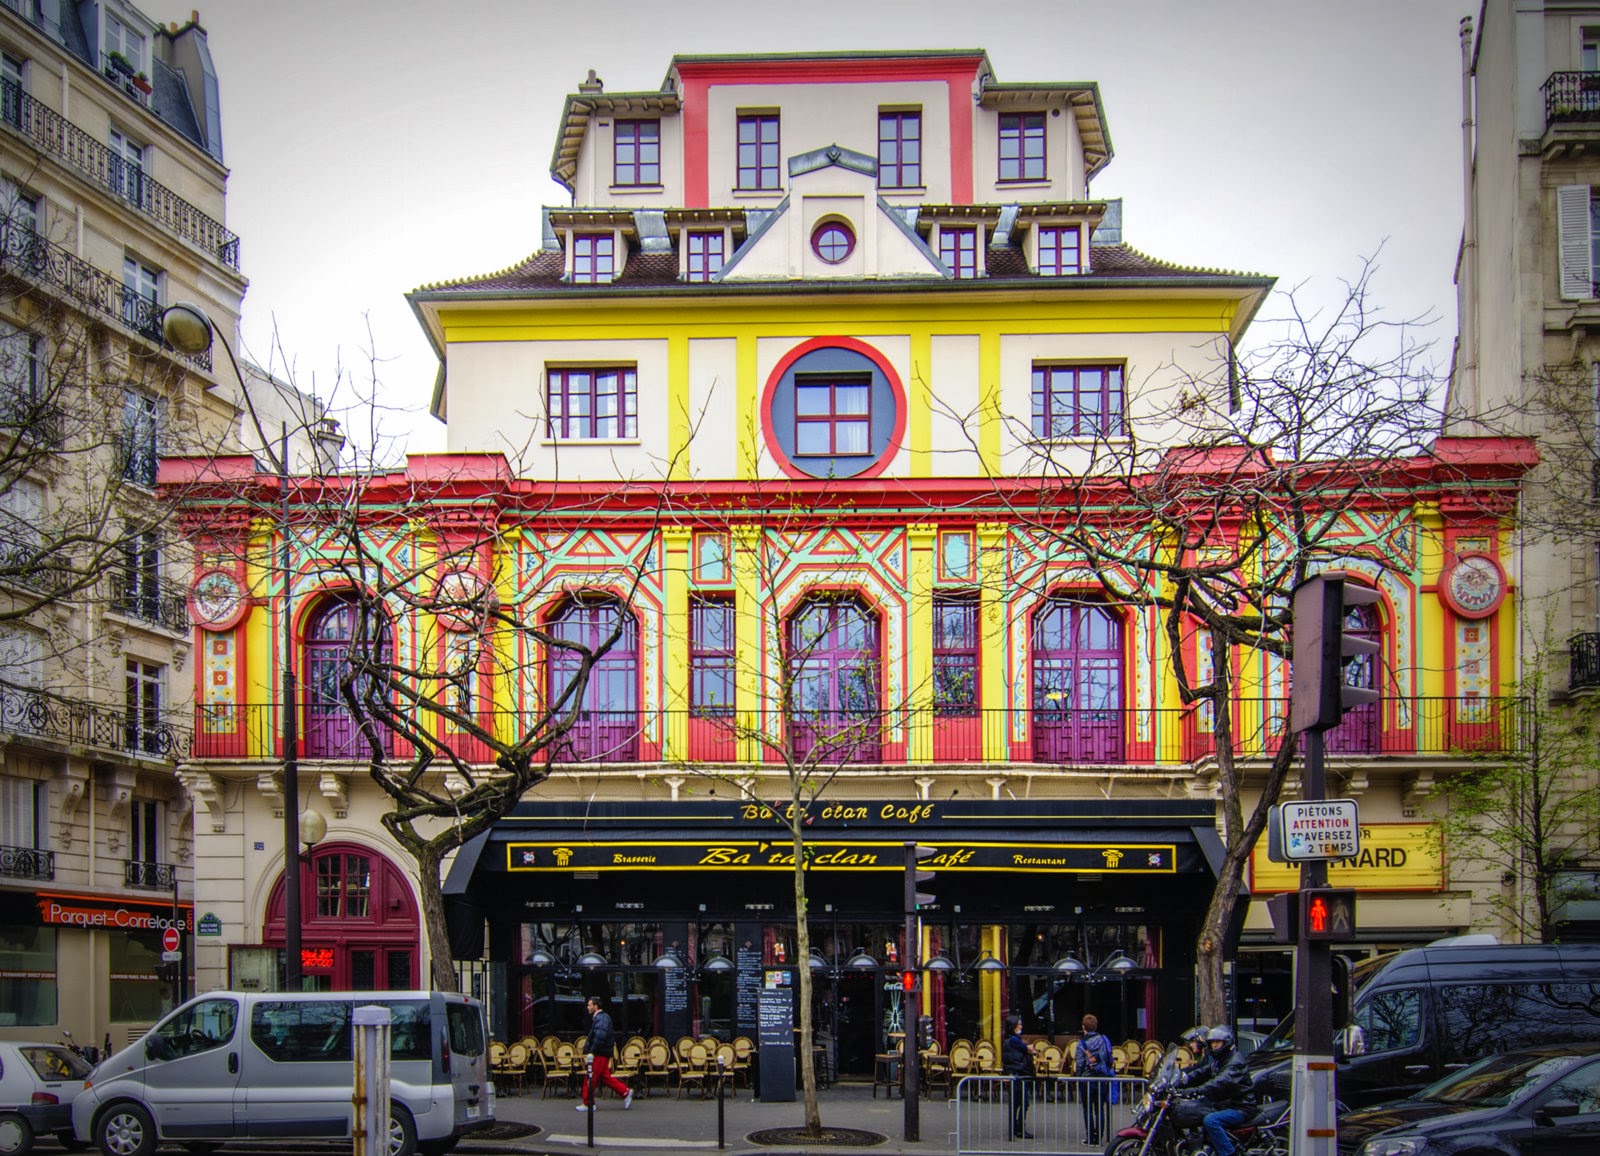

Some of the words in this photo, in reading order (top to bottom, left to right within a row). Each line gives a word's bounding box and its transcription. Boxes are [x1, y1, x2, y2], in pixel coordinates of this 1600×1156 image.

[821, 804, 869, 820] clan
[880, 803, 935, 824] Café
[1297, 805, 1343, 817] PIÉTONS
[1293, 818, 1350, 830] ATTENTION
[1307, 844, 1315, 854] 2
[1318, 842, 1354, 853] TEMPS
[613, 853, 657, 864] Brasserie
[1012, 854, 1067, 866] Restaurant
